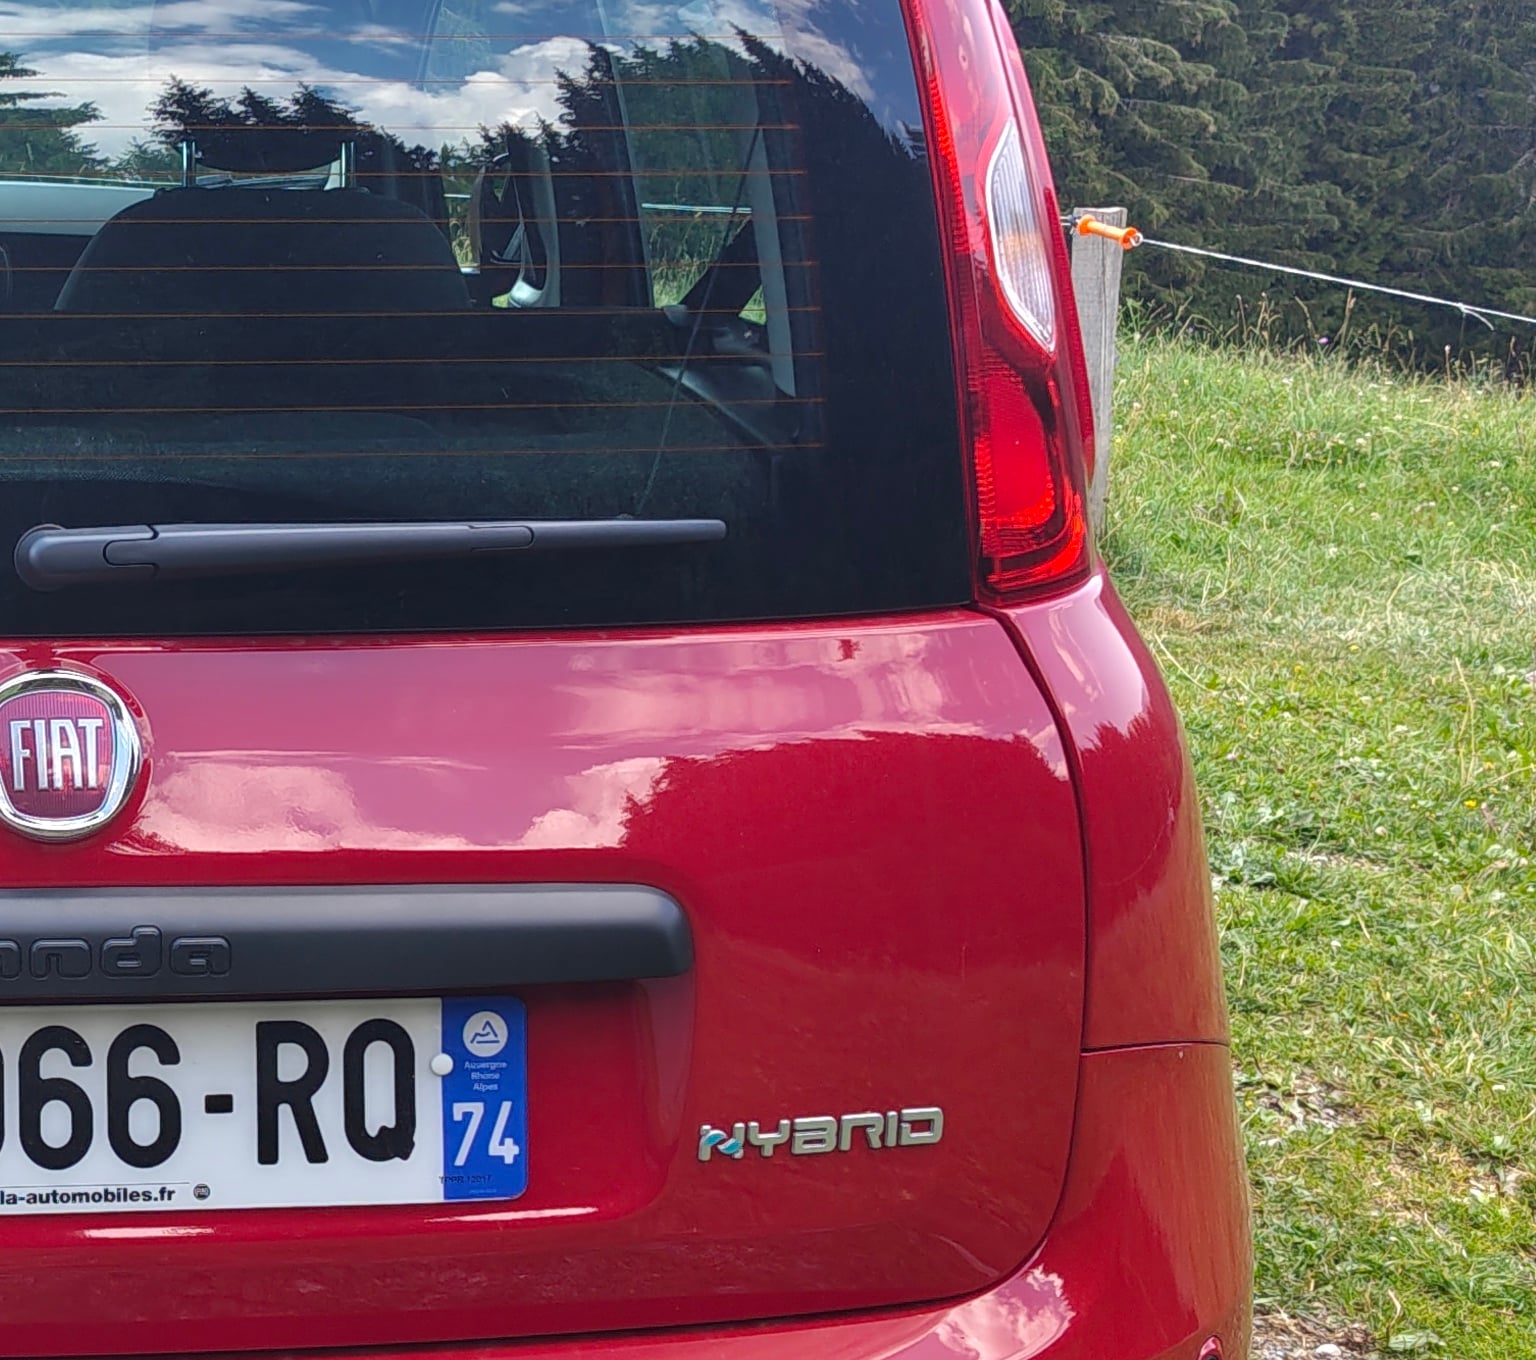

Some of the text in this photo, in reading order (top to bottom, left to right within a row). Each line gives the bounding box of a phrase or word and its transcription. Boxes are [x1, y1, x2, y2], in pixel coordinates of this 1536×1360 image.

[9, 717, 104, 792] FIAT
[452, 1101, 520, 1167] 74
[698, 1107, 943, 1161] HYBRID
